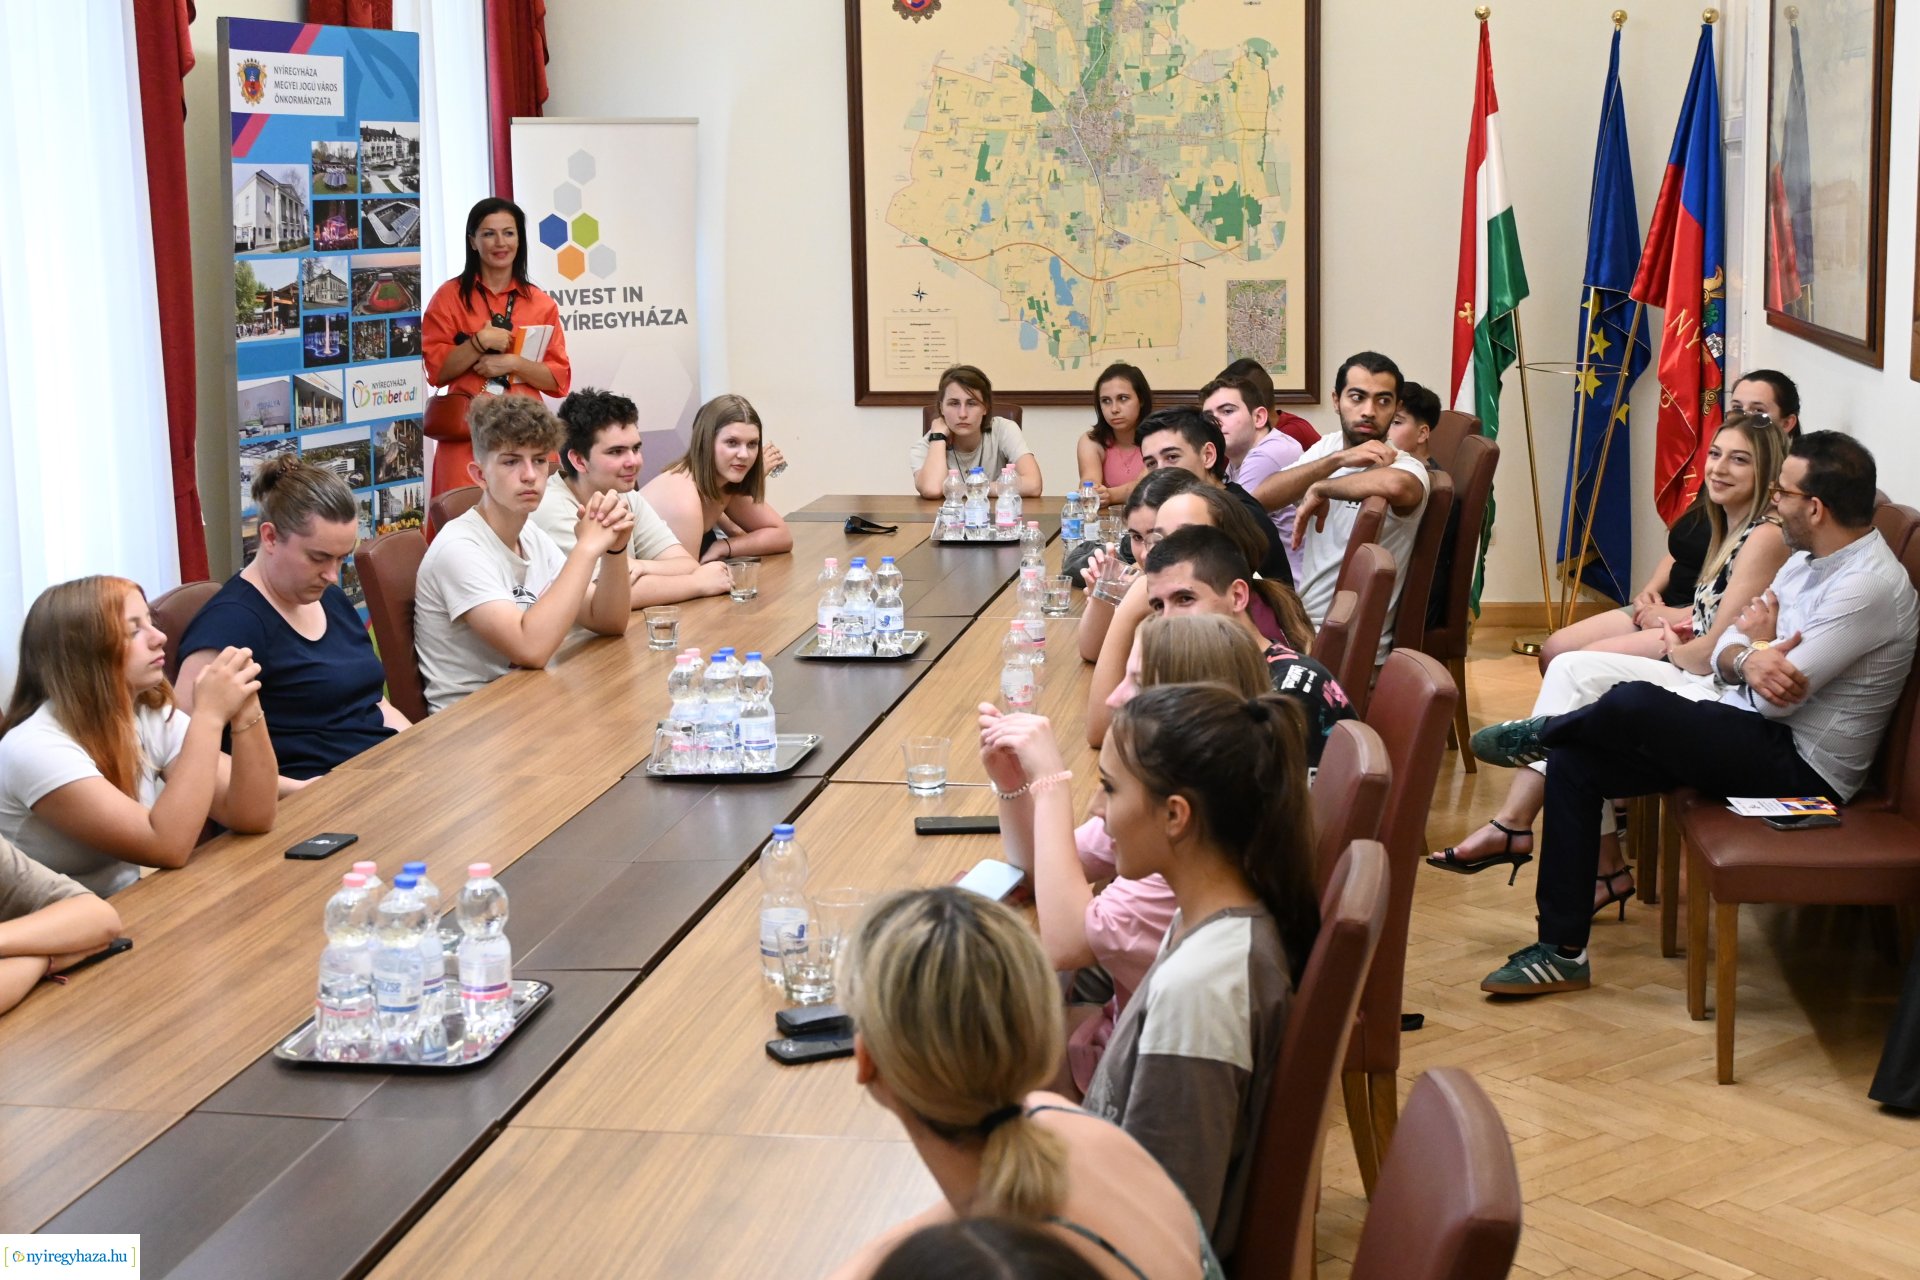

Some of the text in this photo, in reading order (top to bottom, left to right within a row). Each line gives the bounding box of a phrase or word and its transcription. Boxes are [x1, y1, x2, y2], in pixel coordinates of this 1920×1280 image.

[273, 66, 318, 77] NYÍREGYHÁZA
[274, 80, 298, 91] MEGYEI
[317, 80, 338, 92] VÁROS
[275, 94, 332, 106] ÖNKORMÁNYZATA
[544, 286, 643, 306] NVEST IN
[559, 306, 689, 331] YÍREGYHÁZA
[372, 389, 402, 406] Többet
